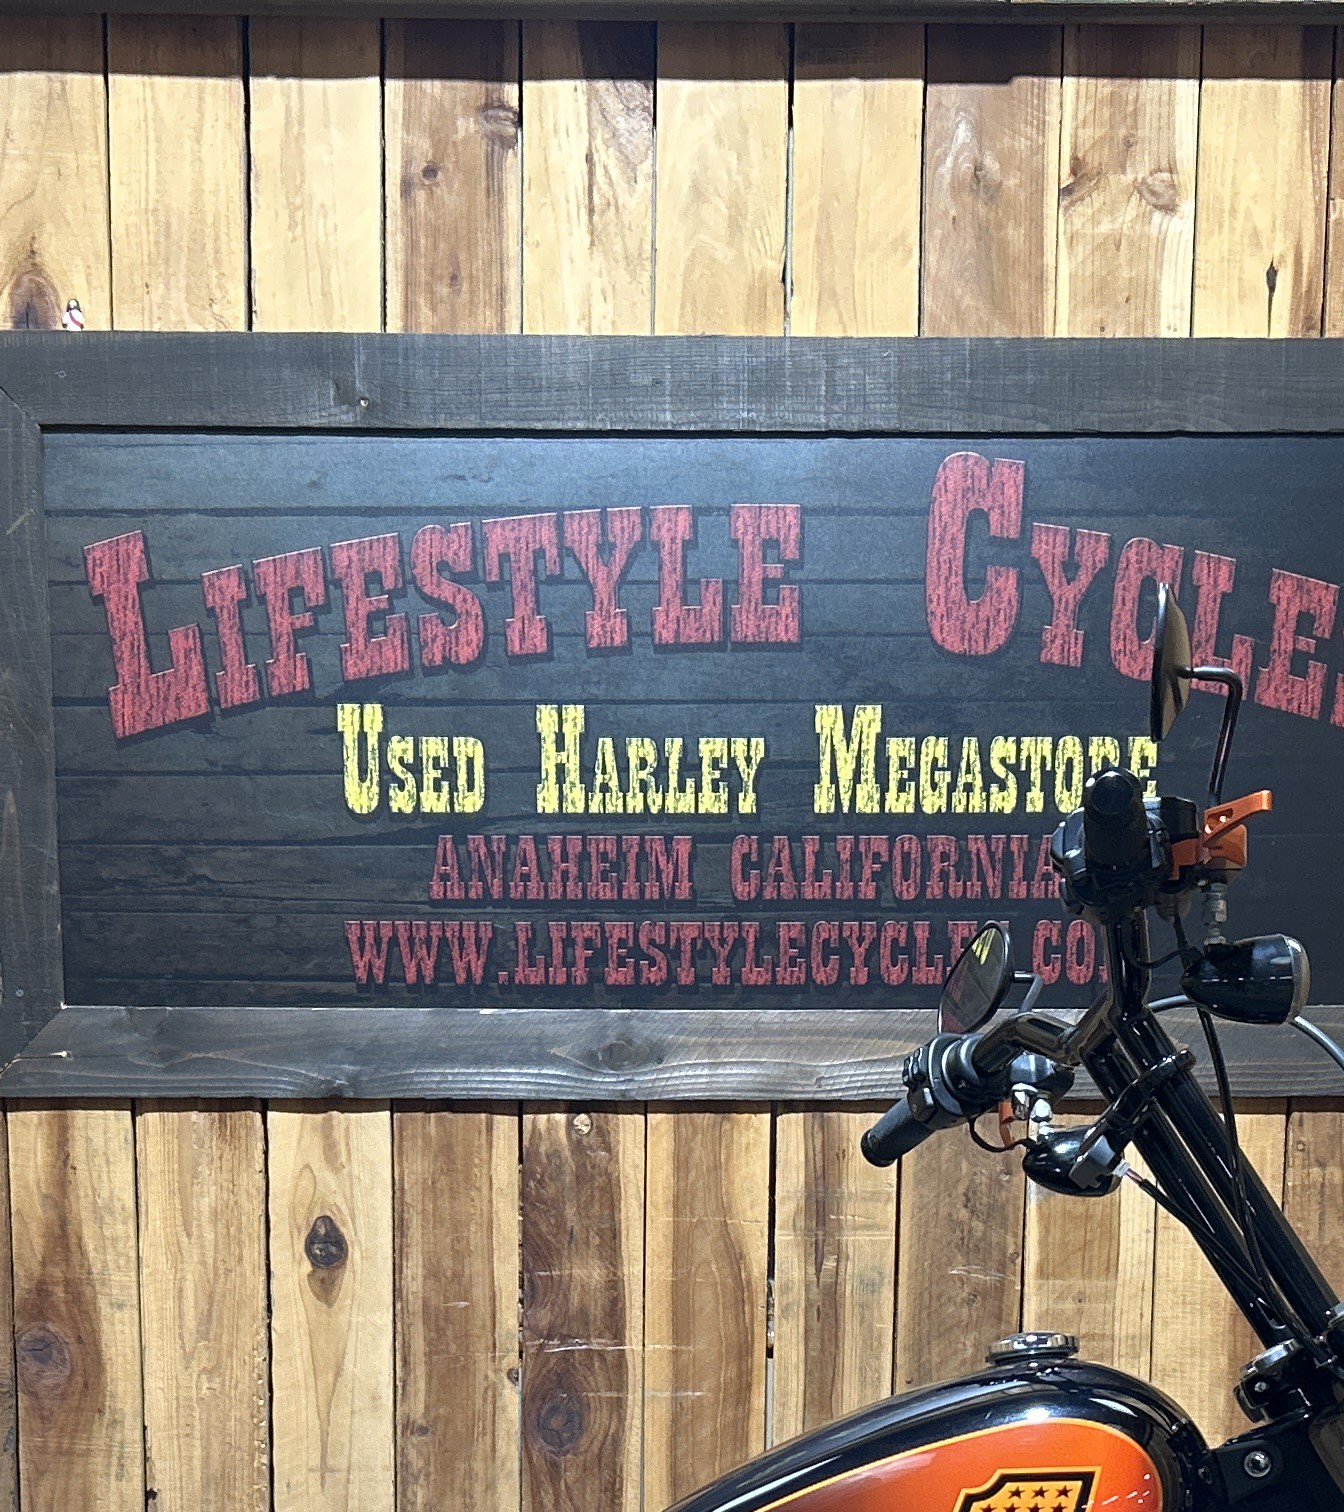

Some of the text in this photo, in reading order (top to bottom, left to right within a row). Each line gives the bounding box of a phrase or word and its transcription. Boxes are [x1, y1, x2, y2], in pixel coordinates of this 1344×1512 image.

[83, 504, 802, 740] LIFESTYLE
[336, 703, 486, 815] USED
[536, 703, 766, 815] HARLEY
[429, 833, 1061, 902] ANAHEIM CALIFORNIA
